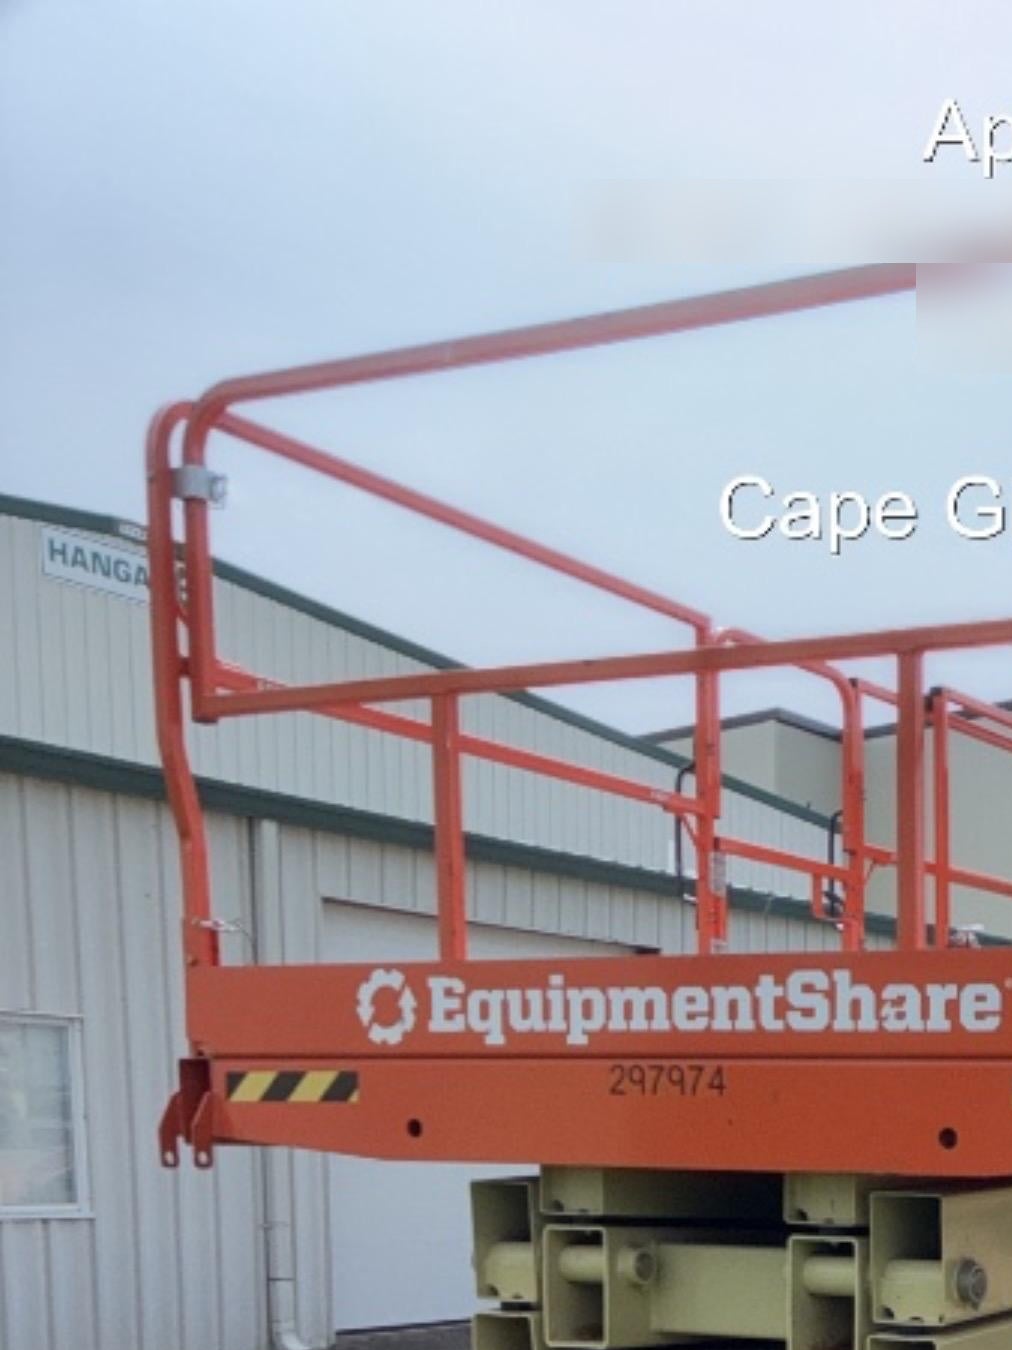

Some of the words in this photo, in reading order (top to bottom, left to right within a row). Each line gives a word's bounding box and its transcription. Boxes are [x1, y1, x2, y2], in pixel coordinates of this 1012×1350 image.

[47, 538, 149, 588] HANGA
[428, 969, 1003, 1045] EquipmentShare
[608, 1064, 728, 1097] 297974
